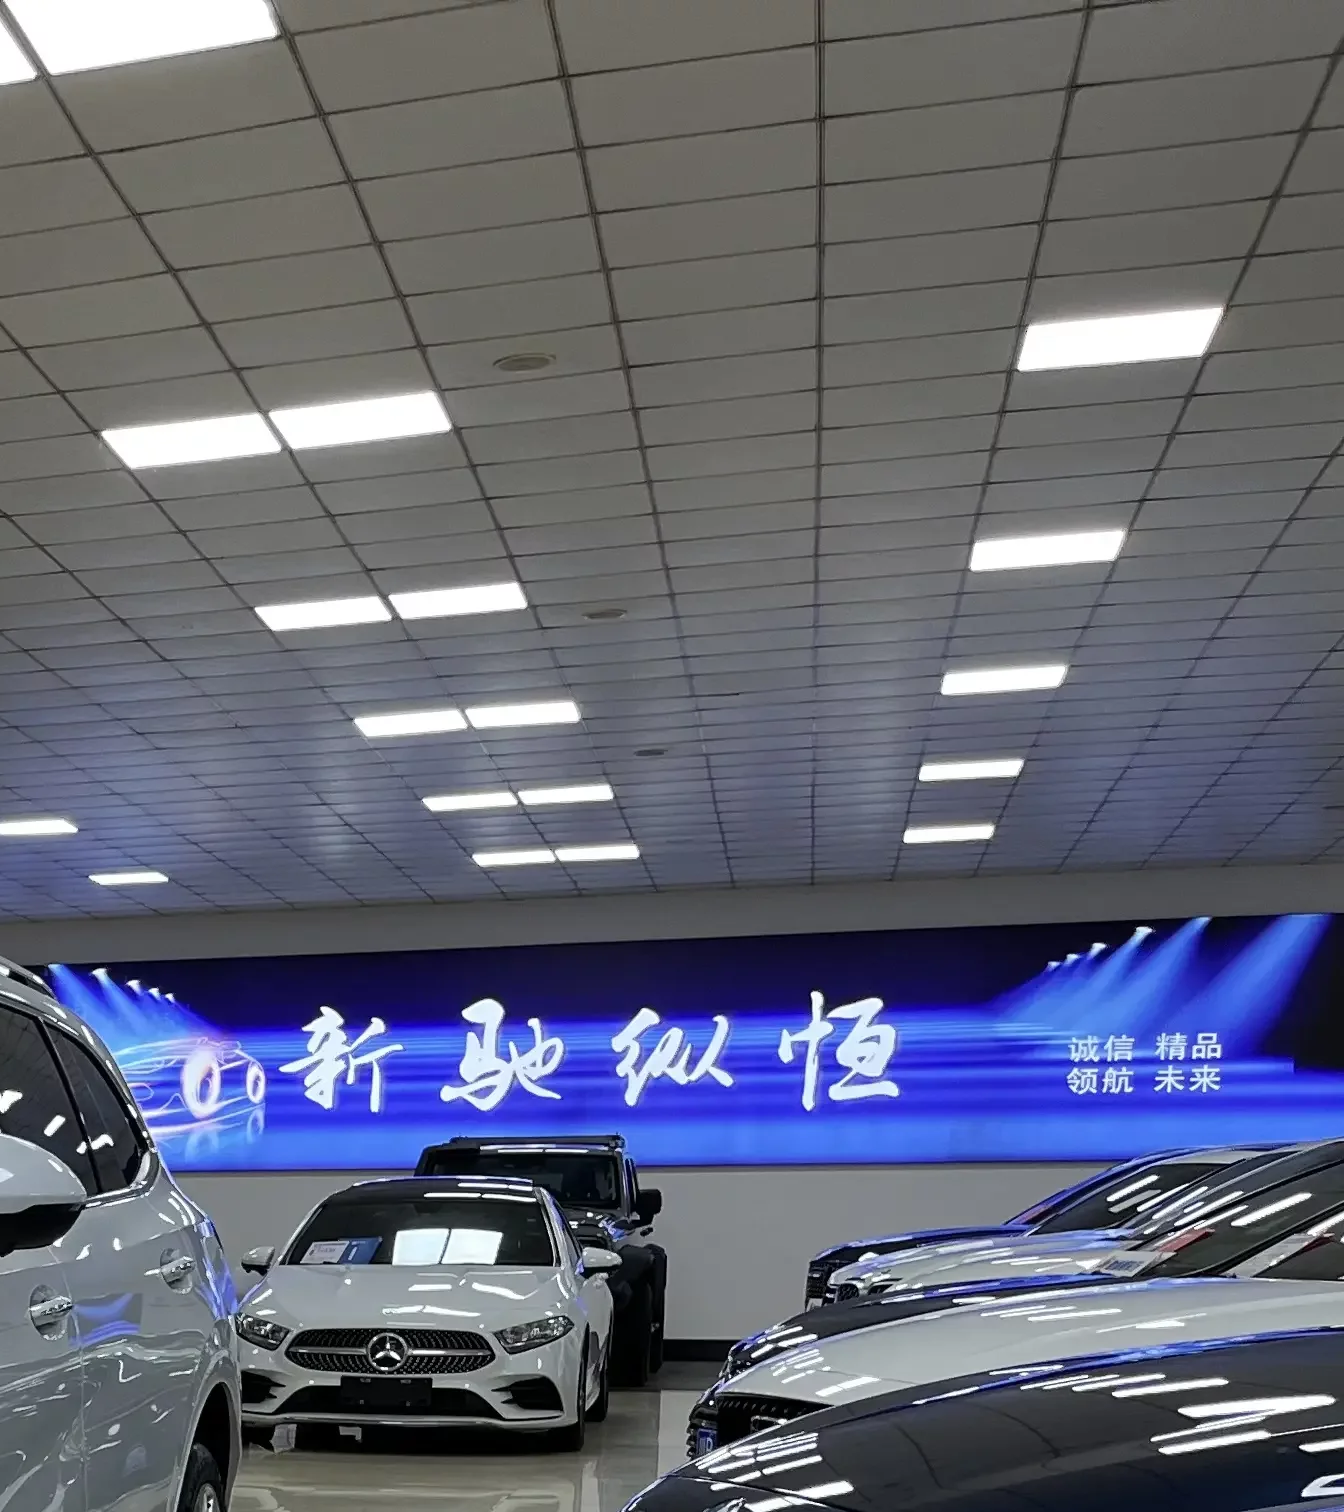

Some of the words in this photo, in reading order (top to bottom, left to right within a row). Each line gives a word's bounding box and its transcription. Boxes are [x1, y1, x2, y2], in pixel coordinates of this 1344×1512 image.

[278, 991, 900, 1112] 新驰纵恒
[1068, 1034, 1135, 1063] 诚信
[1155, 1032, 1222, 1061] 精品
[1066, 1066, 1135, 1095] 领航
[1154, 1064, 1221, 1093] 未来
